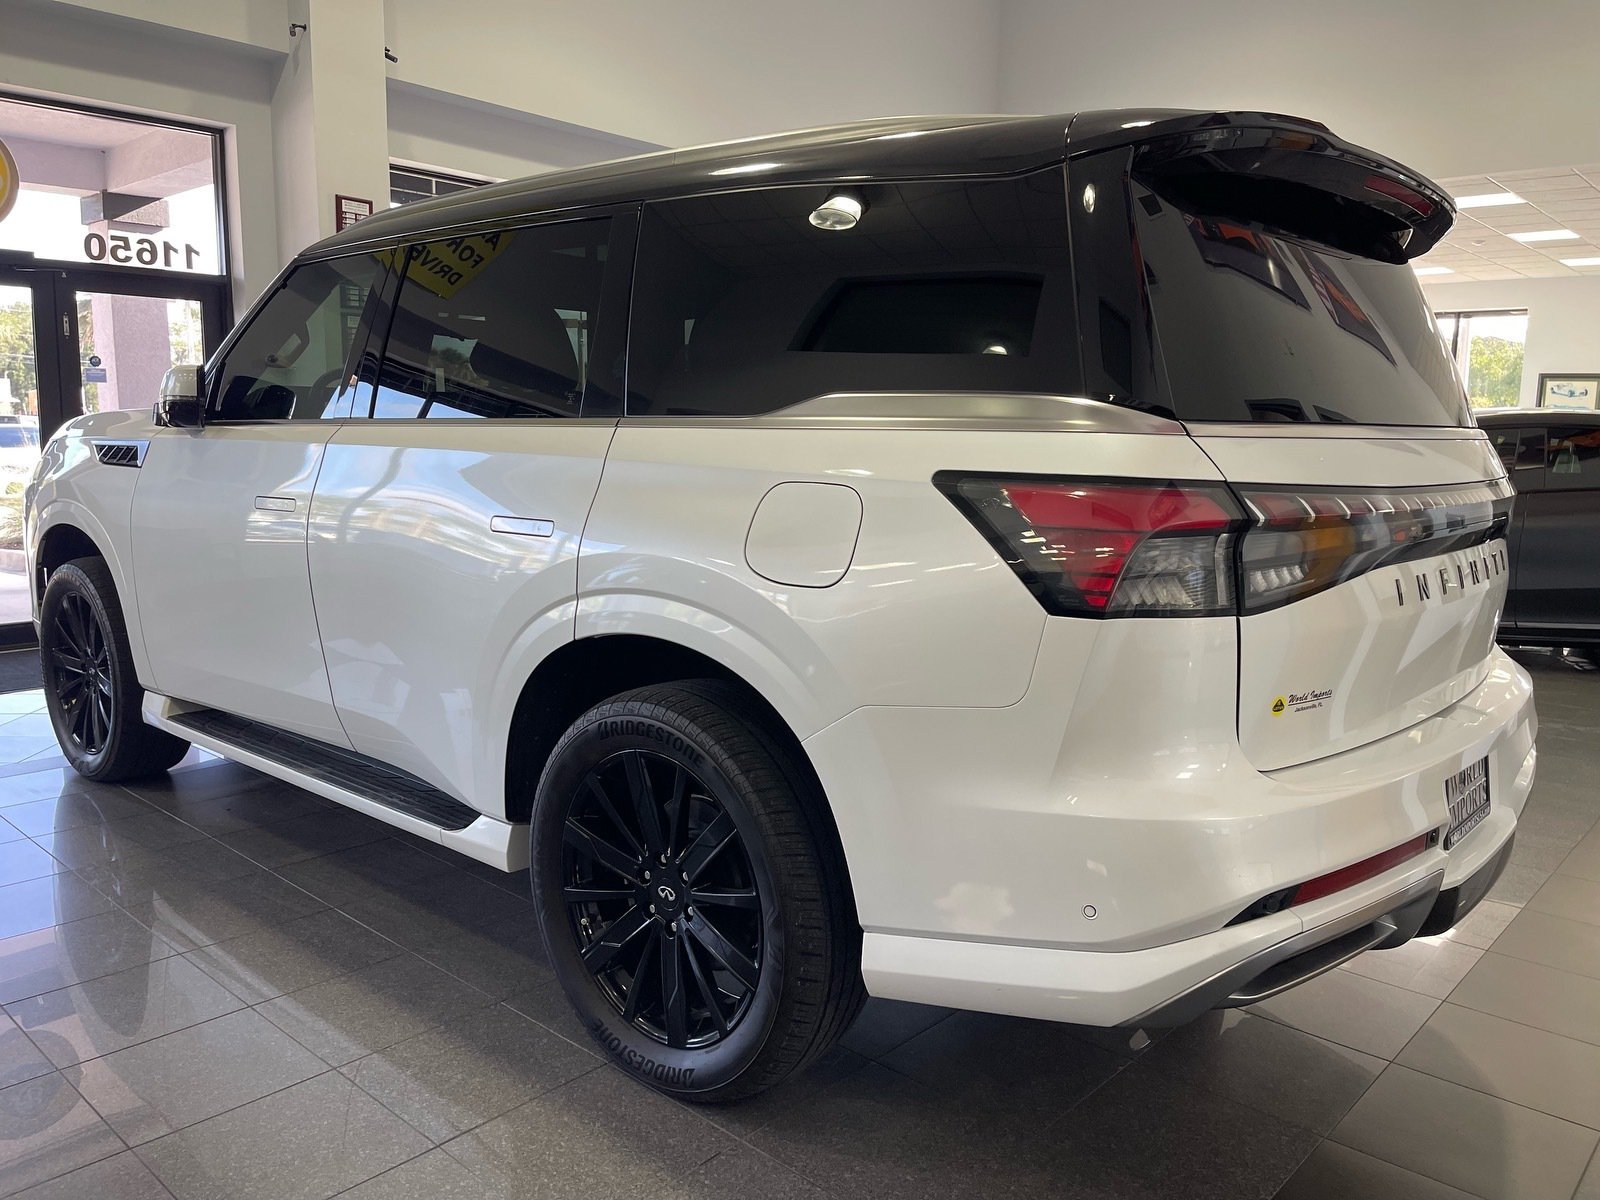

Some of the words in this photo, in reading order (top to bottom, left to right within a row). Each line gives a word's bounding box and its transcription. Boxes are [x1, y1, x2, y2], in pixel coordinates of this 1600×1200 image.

[1395, 549, 1507, 607] INFINITI
[597, 719, 706, 769] BRIDGESTONE
[590, 1018, 696, 1089] BRIDGESTONE
